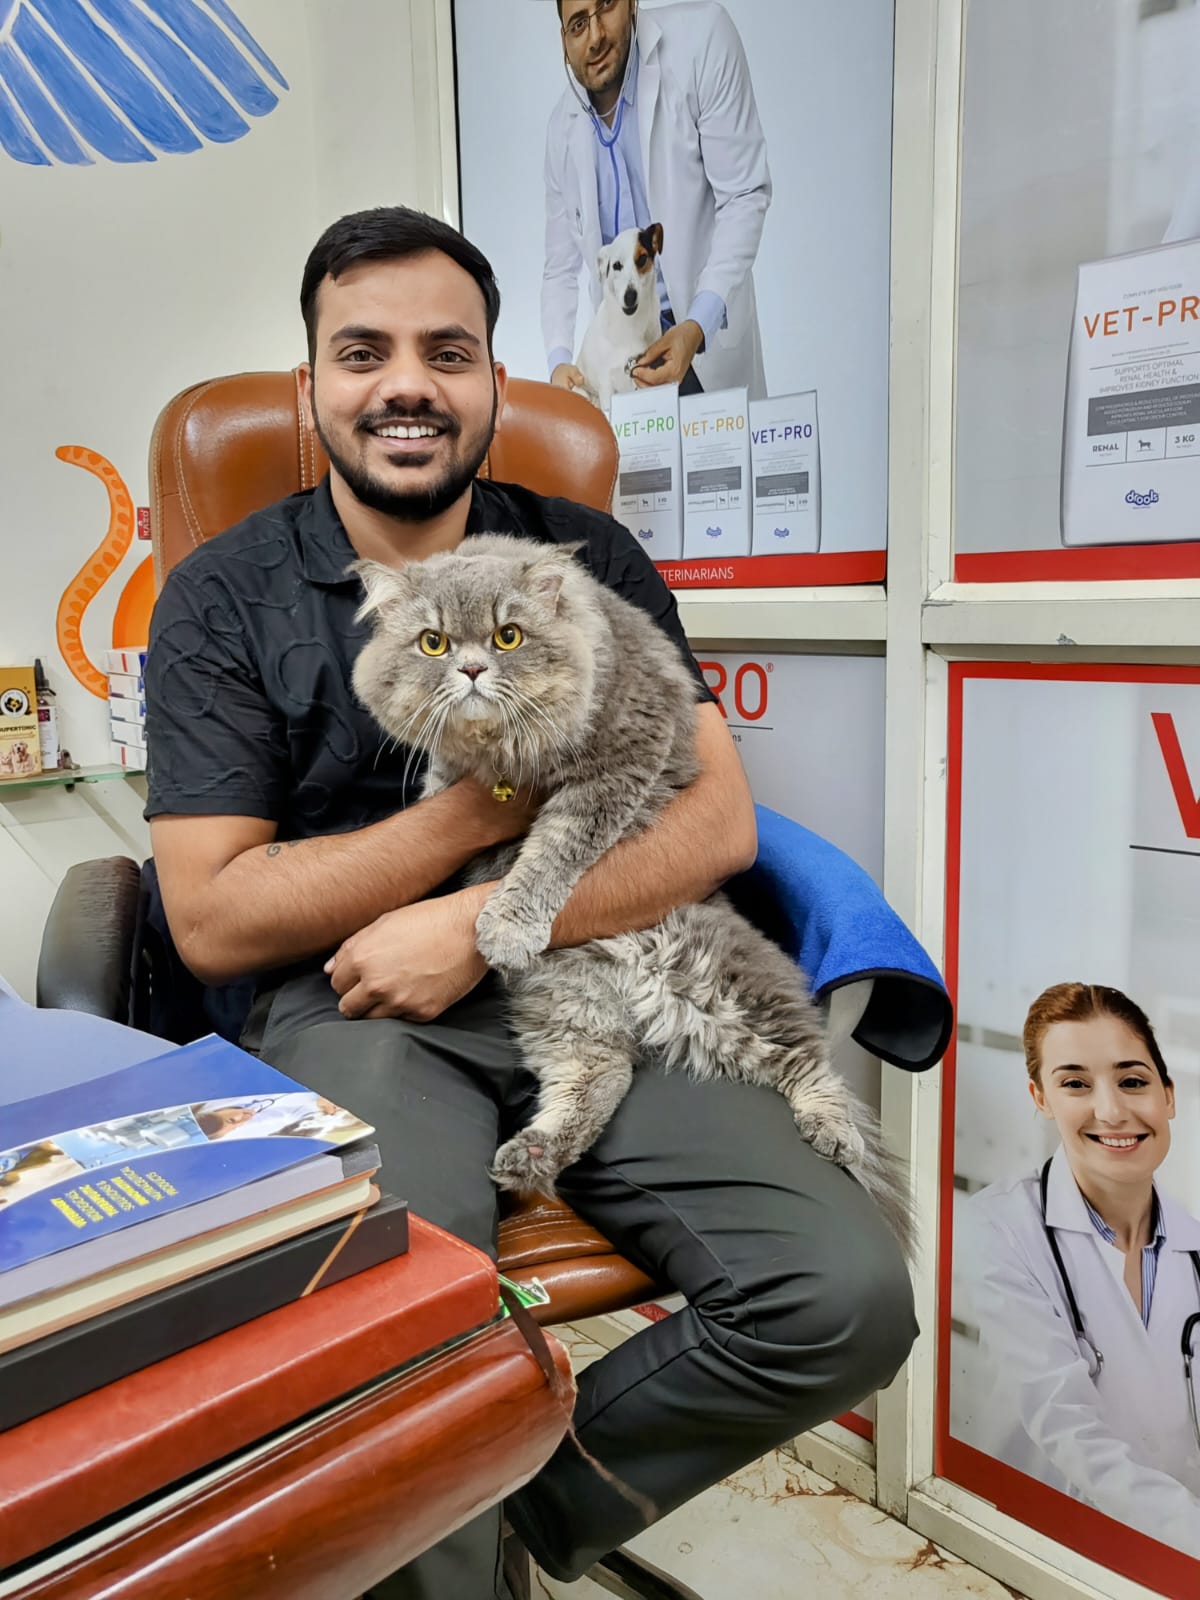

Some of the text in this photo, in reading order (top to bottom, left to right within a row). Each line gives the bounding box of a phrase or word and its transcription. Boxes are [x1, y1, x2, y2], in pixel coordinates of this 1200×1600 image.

[1114, 359, 1184, 376] SUPPORTS OPTIMAL
[1119, 374, 1141, 383] RENAL
[1143, 369, 1170, 379] HEALTH
[1099, 373, 1199, 393] IMPROVES KIDNEY FUNCTION
[615, 416, 675, 438] VET-PRO
[682, 415, 745, 438] VET-PRO
[752, 424, 812, 445] VET-PRO
[1181, 434, 1196, 444] KG
[1092, 443, 1120, 453] RENAL
[1125, 489, 1160, 506] drools
